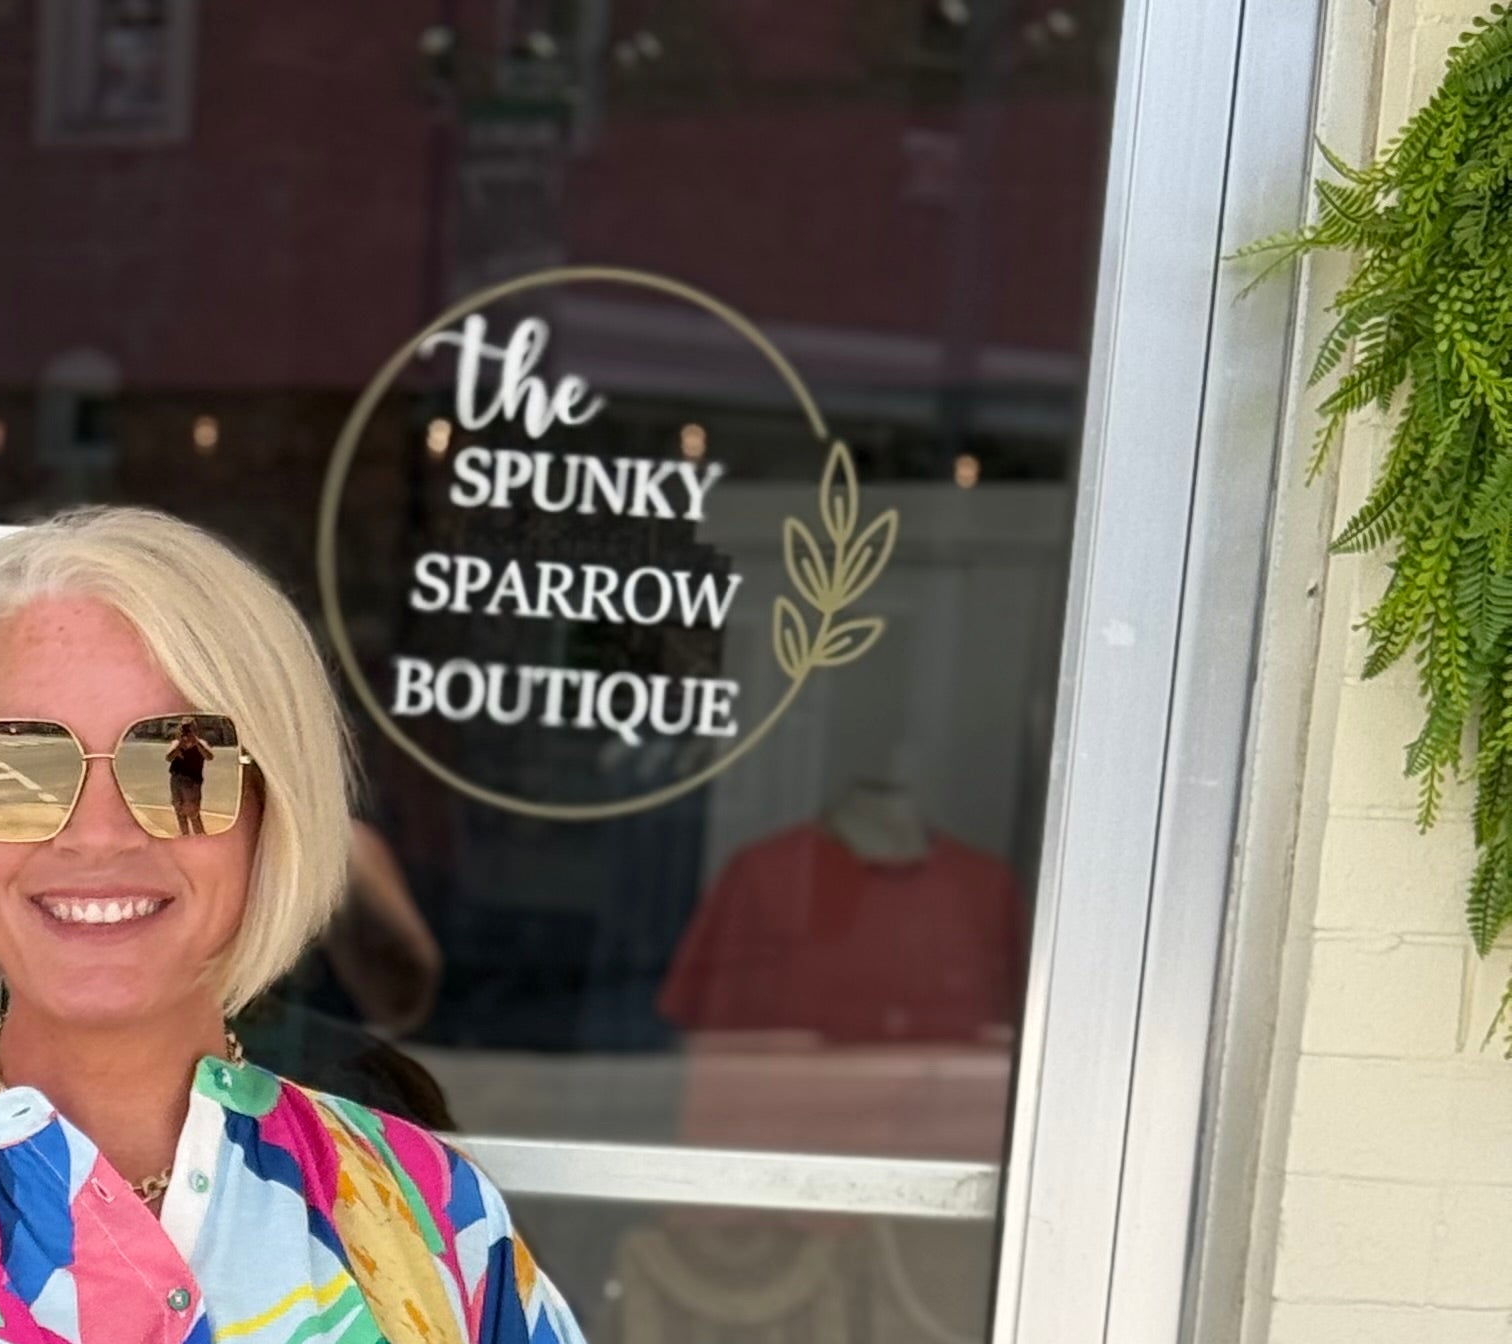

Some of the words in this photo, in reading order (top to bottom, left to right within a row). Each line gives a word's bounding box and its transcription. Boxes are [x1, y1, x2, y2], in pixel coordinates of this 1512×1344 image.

[419, 313, 605, 438] the
[450, 446, 724, 520] SPUNKY
[409, 553, 742, 629] SPARROW
[394, 657, 740, 747] BOUTIQUE
